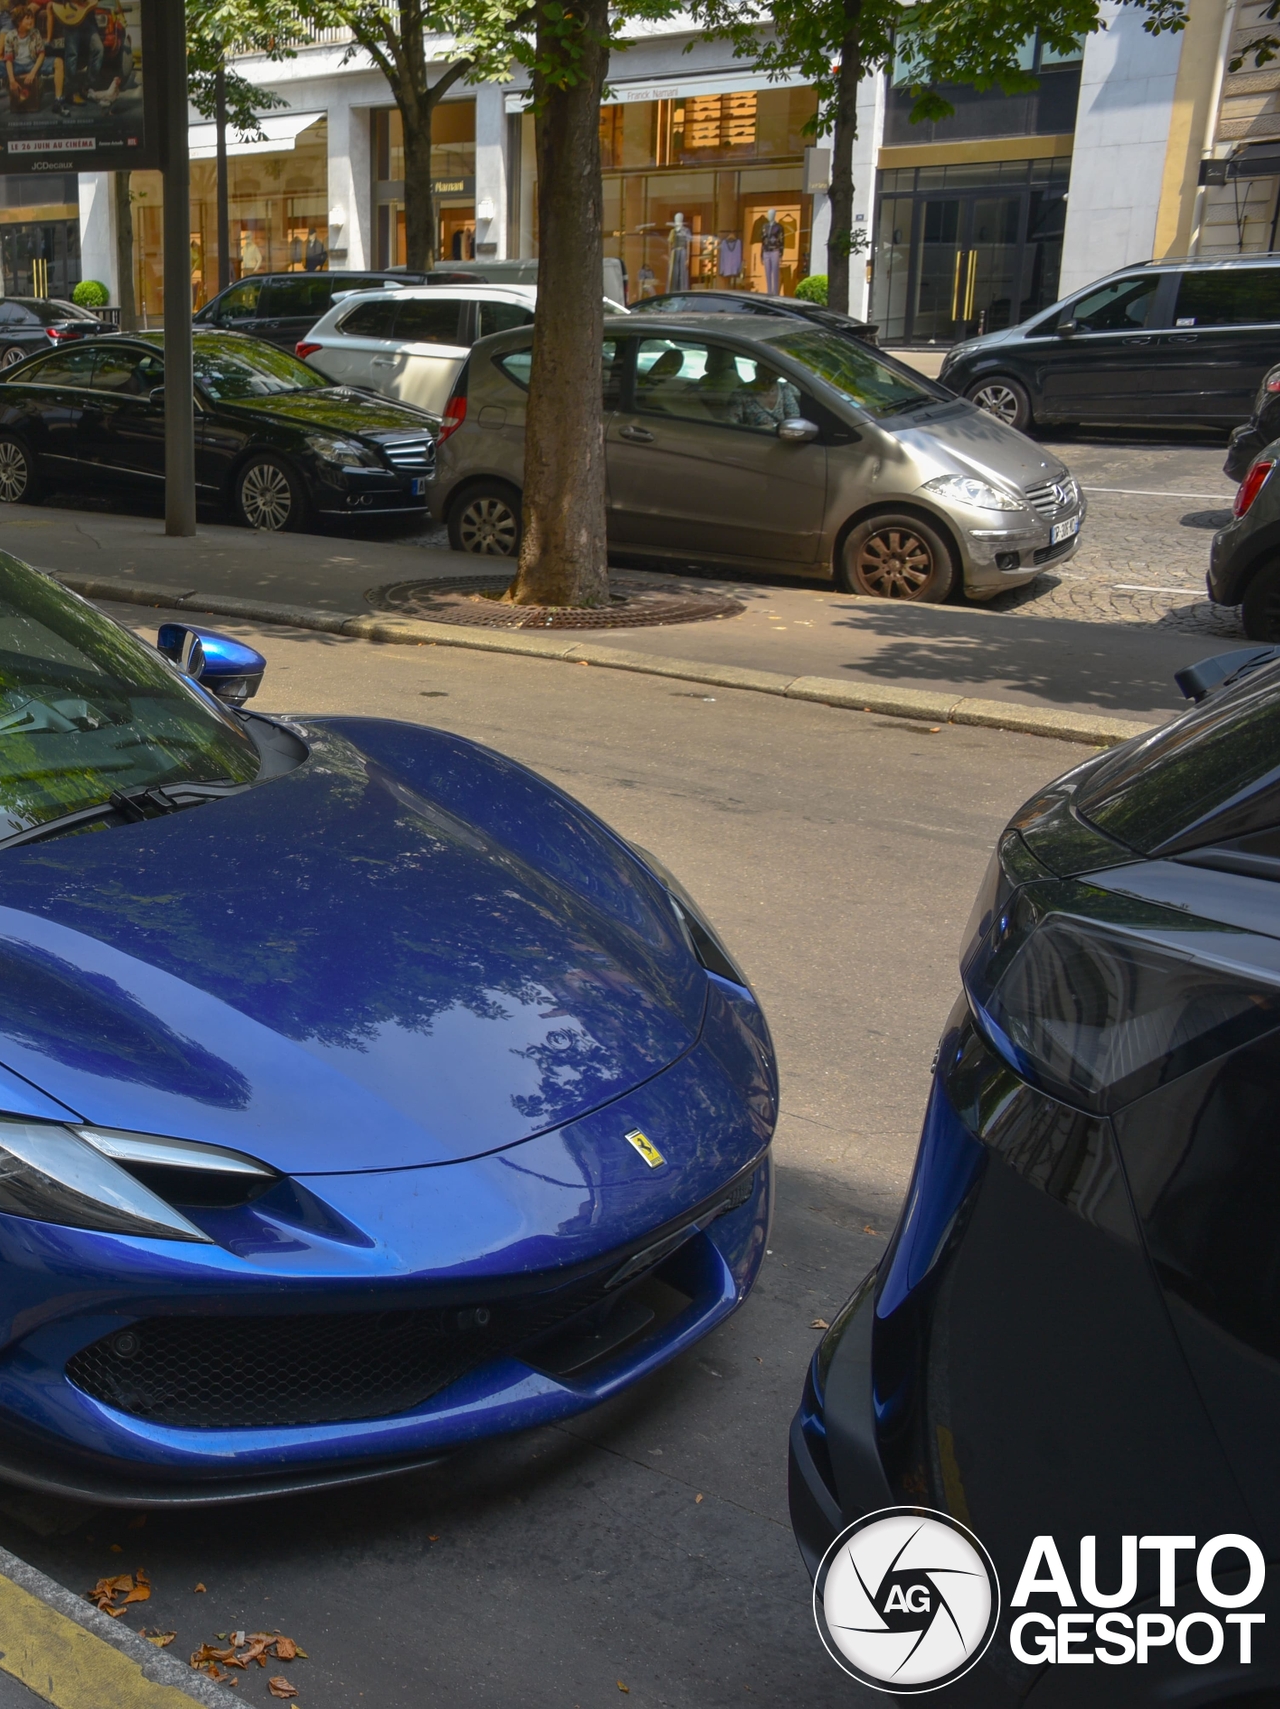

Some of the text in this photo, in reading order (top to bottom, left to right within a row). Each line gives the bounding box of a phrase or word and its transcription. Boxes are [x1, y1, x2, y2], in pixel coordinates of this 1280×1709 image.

[627, 87, 679, 100] Franck Namani
[34, 142, 50, 150] JUIN
[65, 140, 94, 148] CINÉMA
[31, 161, 73, 171] JCDecaux
